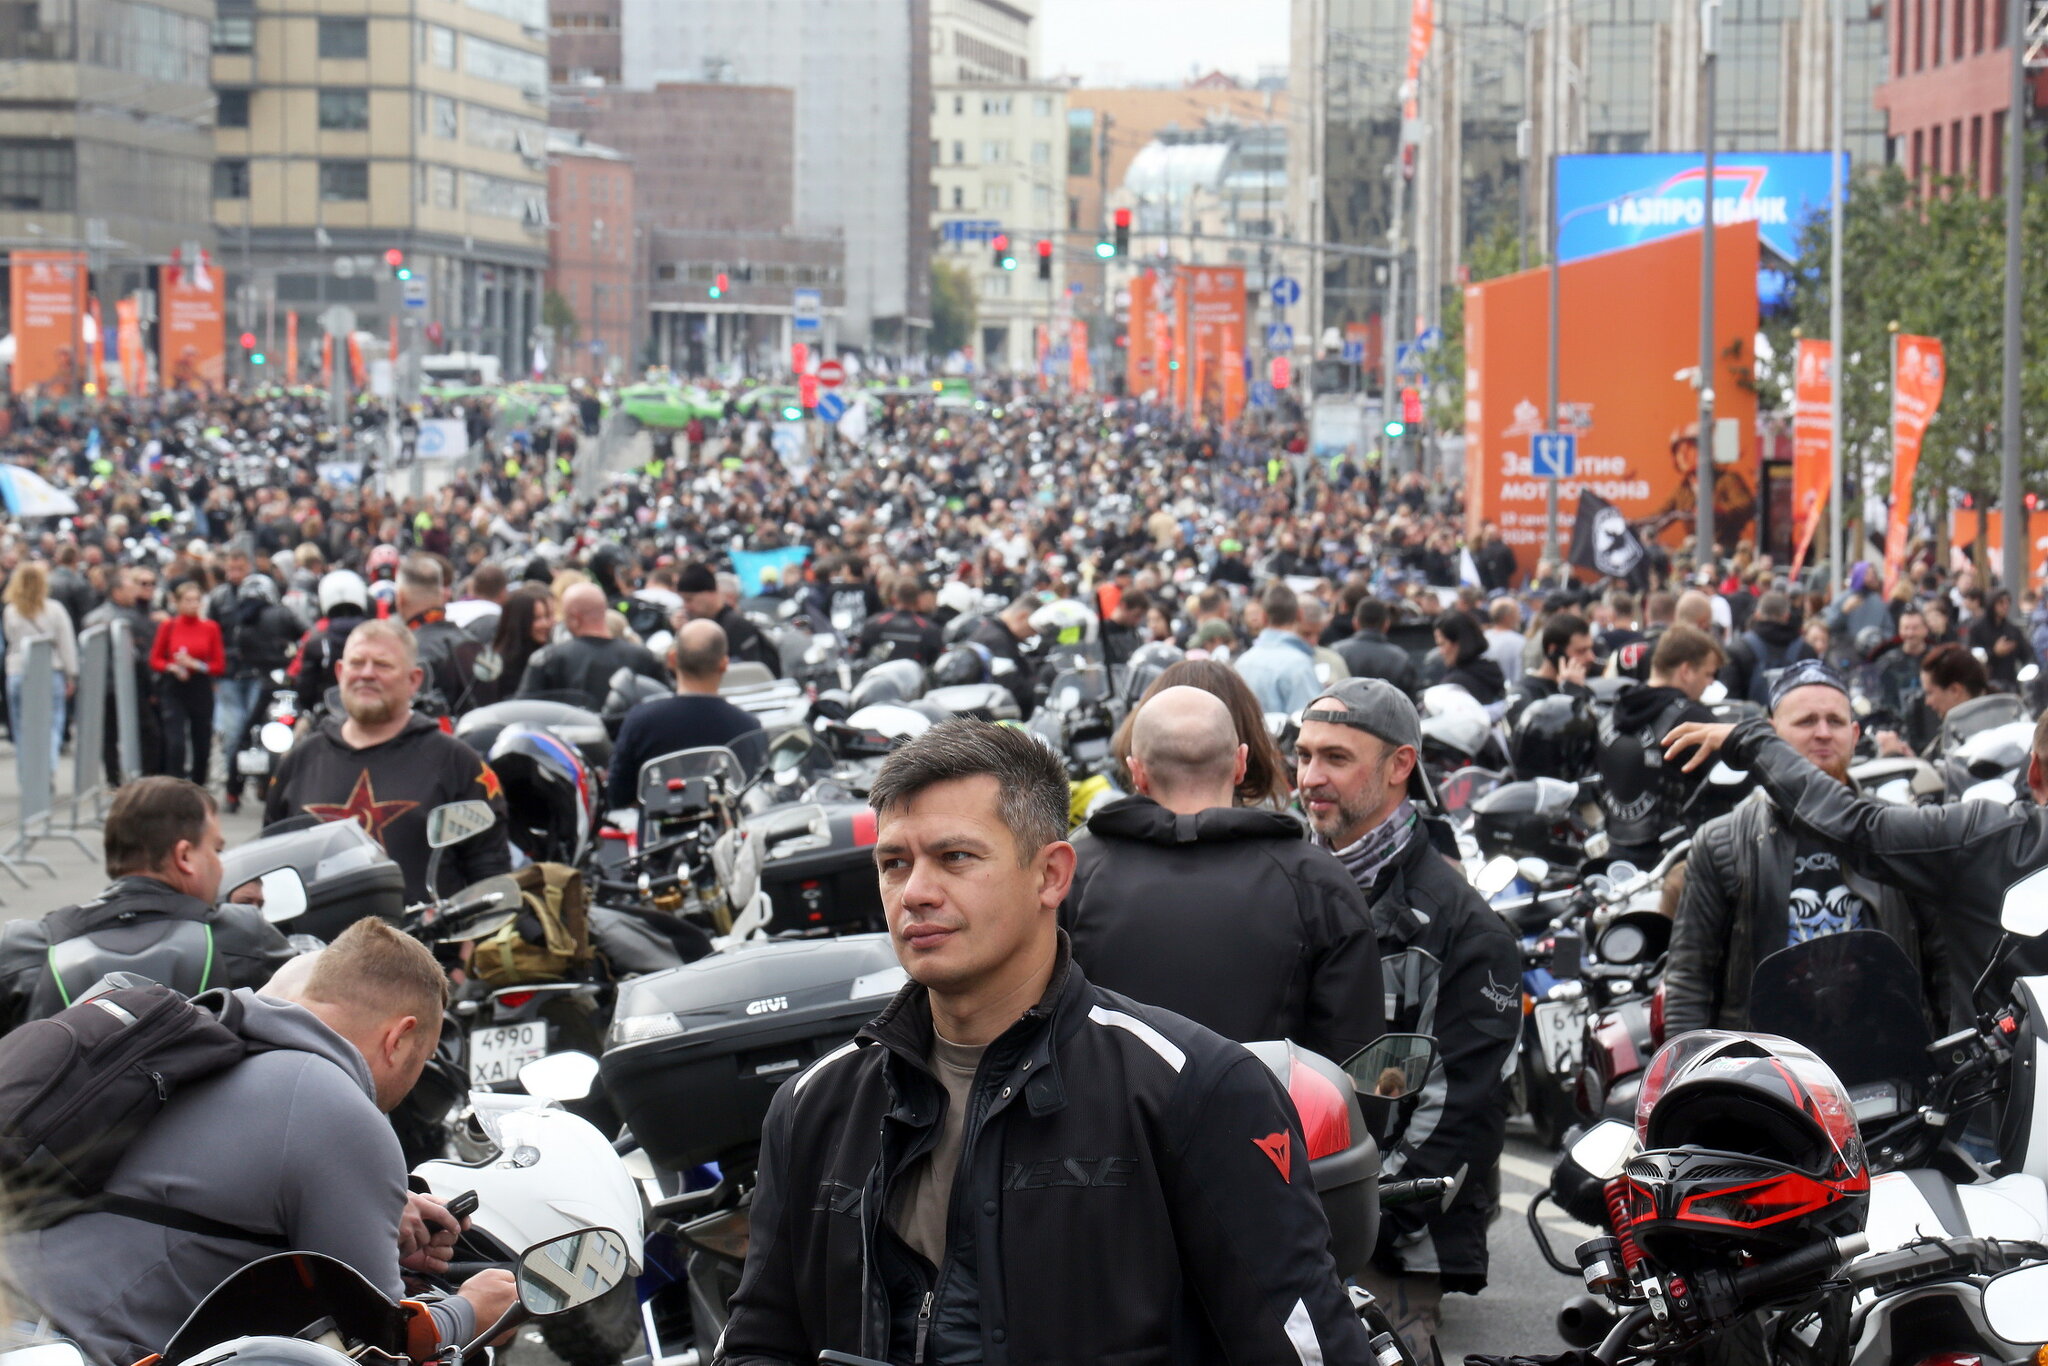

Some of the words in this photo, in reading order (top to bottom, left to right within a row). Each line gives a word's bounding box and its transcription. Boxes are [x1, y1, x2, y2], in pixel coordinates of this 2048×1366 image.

[1501, 450, 1626, 477] Затие
[746, 996, 789, 1015] GIVI
[482, 1027, 533, 1051] 4990
